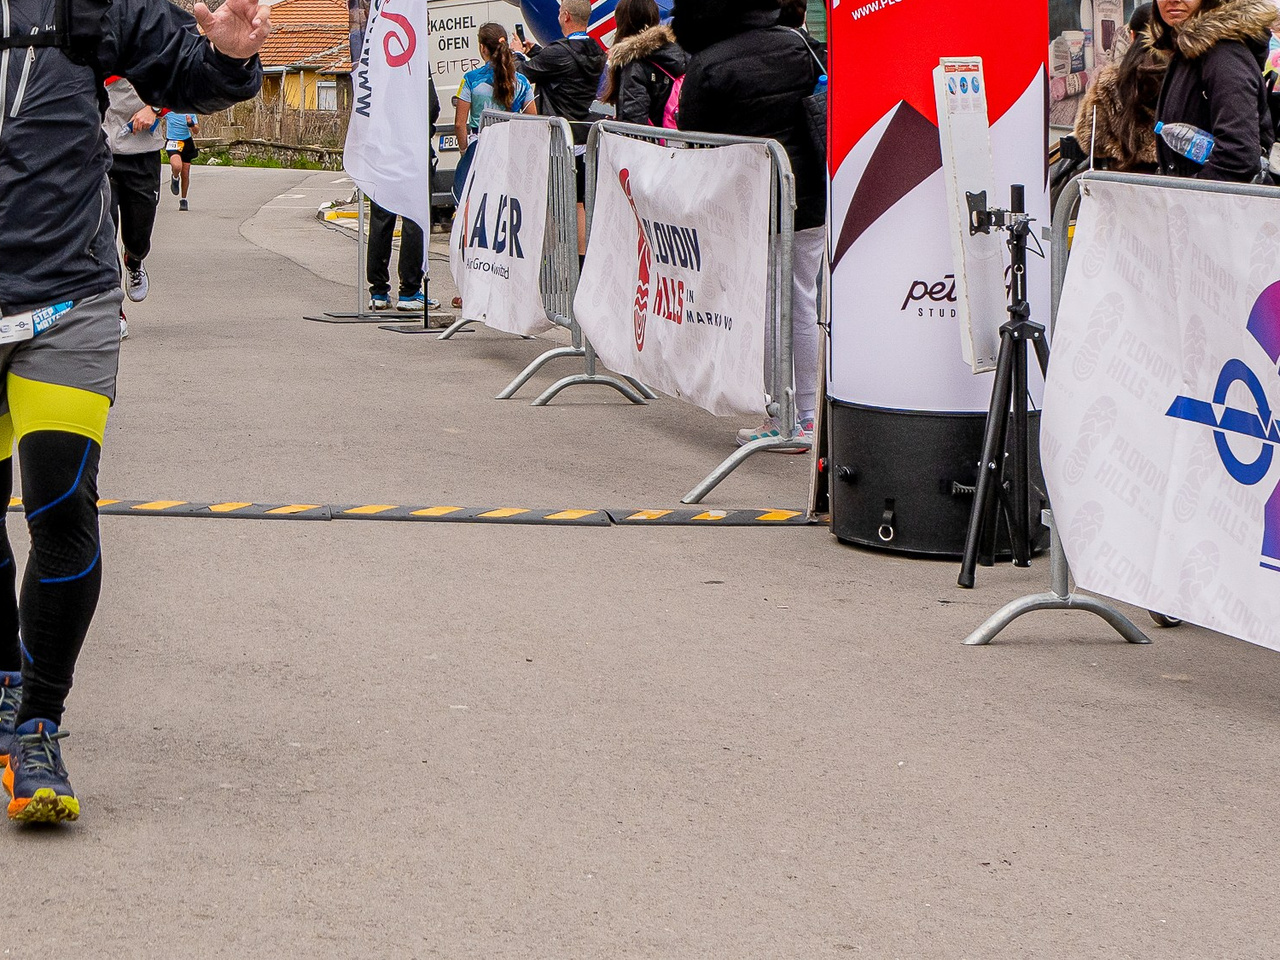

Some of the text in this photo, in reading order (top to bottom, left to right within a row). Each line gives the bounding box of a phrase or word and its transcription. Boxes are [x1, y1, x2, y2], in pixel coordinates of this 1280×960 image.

[438, 35, 469, 51] ÖFEN
[686, 289, 695, 303] IN
[918, 308, 956, 317] STUD
